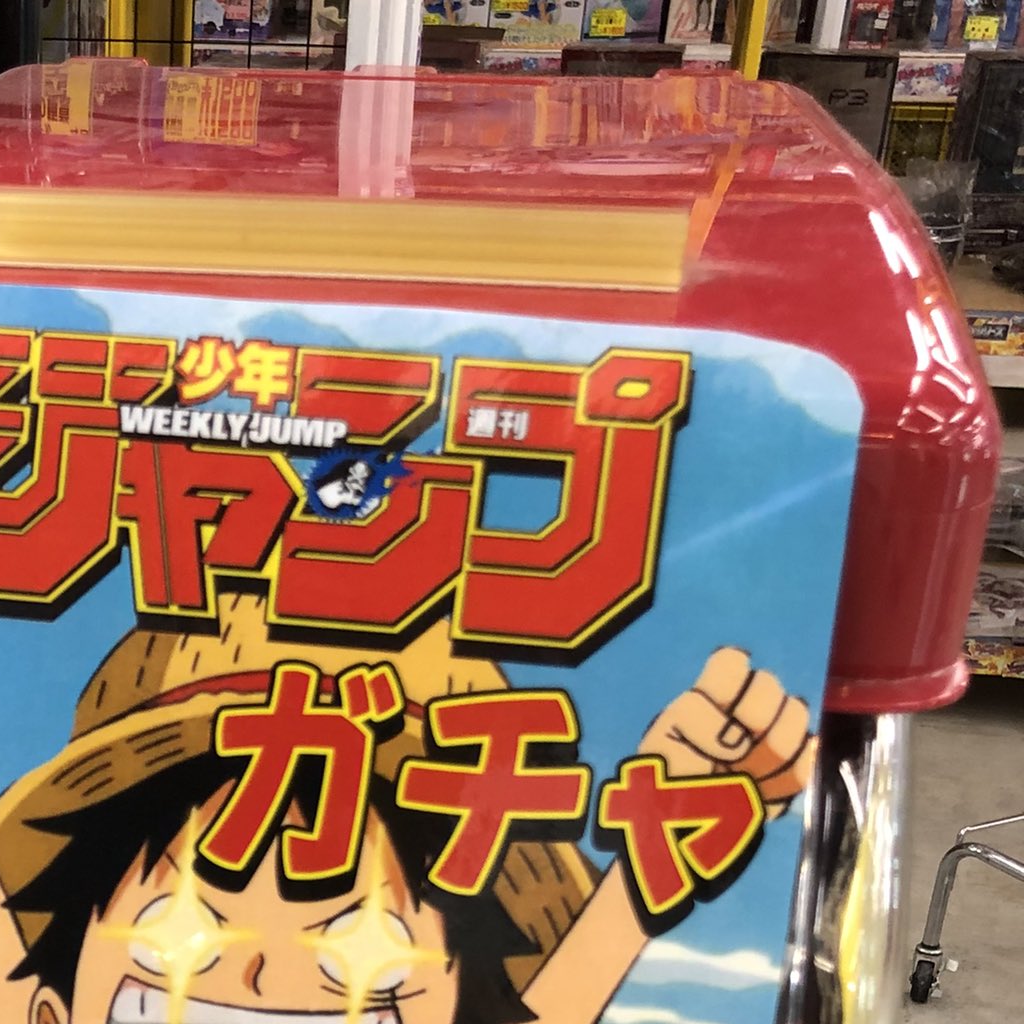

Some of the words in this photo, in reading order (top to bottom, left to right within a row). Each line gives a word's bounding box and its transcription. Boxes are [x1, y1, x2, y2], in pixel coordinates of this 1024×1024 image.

[177, 335, 296, 412] 少年
[119, 403, 249, 441] WEEKLY
[248, 414, 348, 448] JUMP
[465, 405, 531, 443] 週刊
[194, 660, 768, 915] ガチャ
